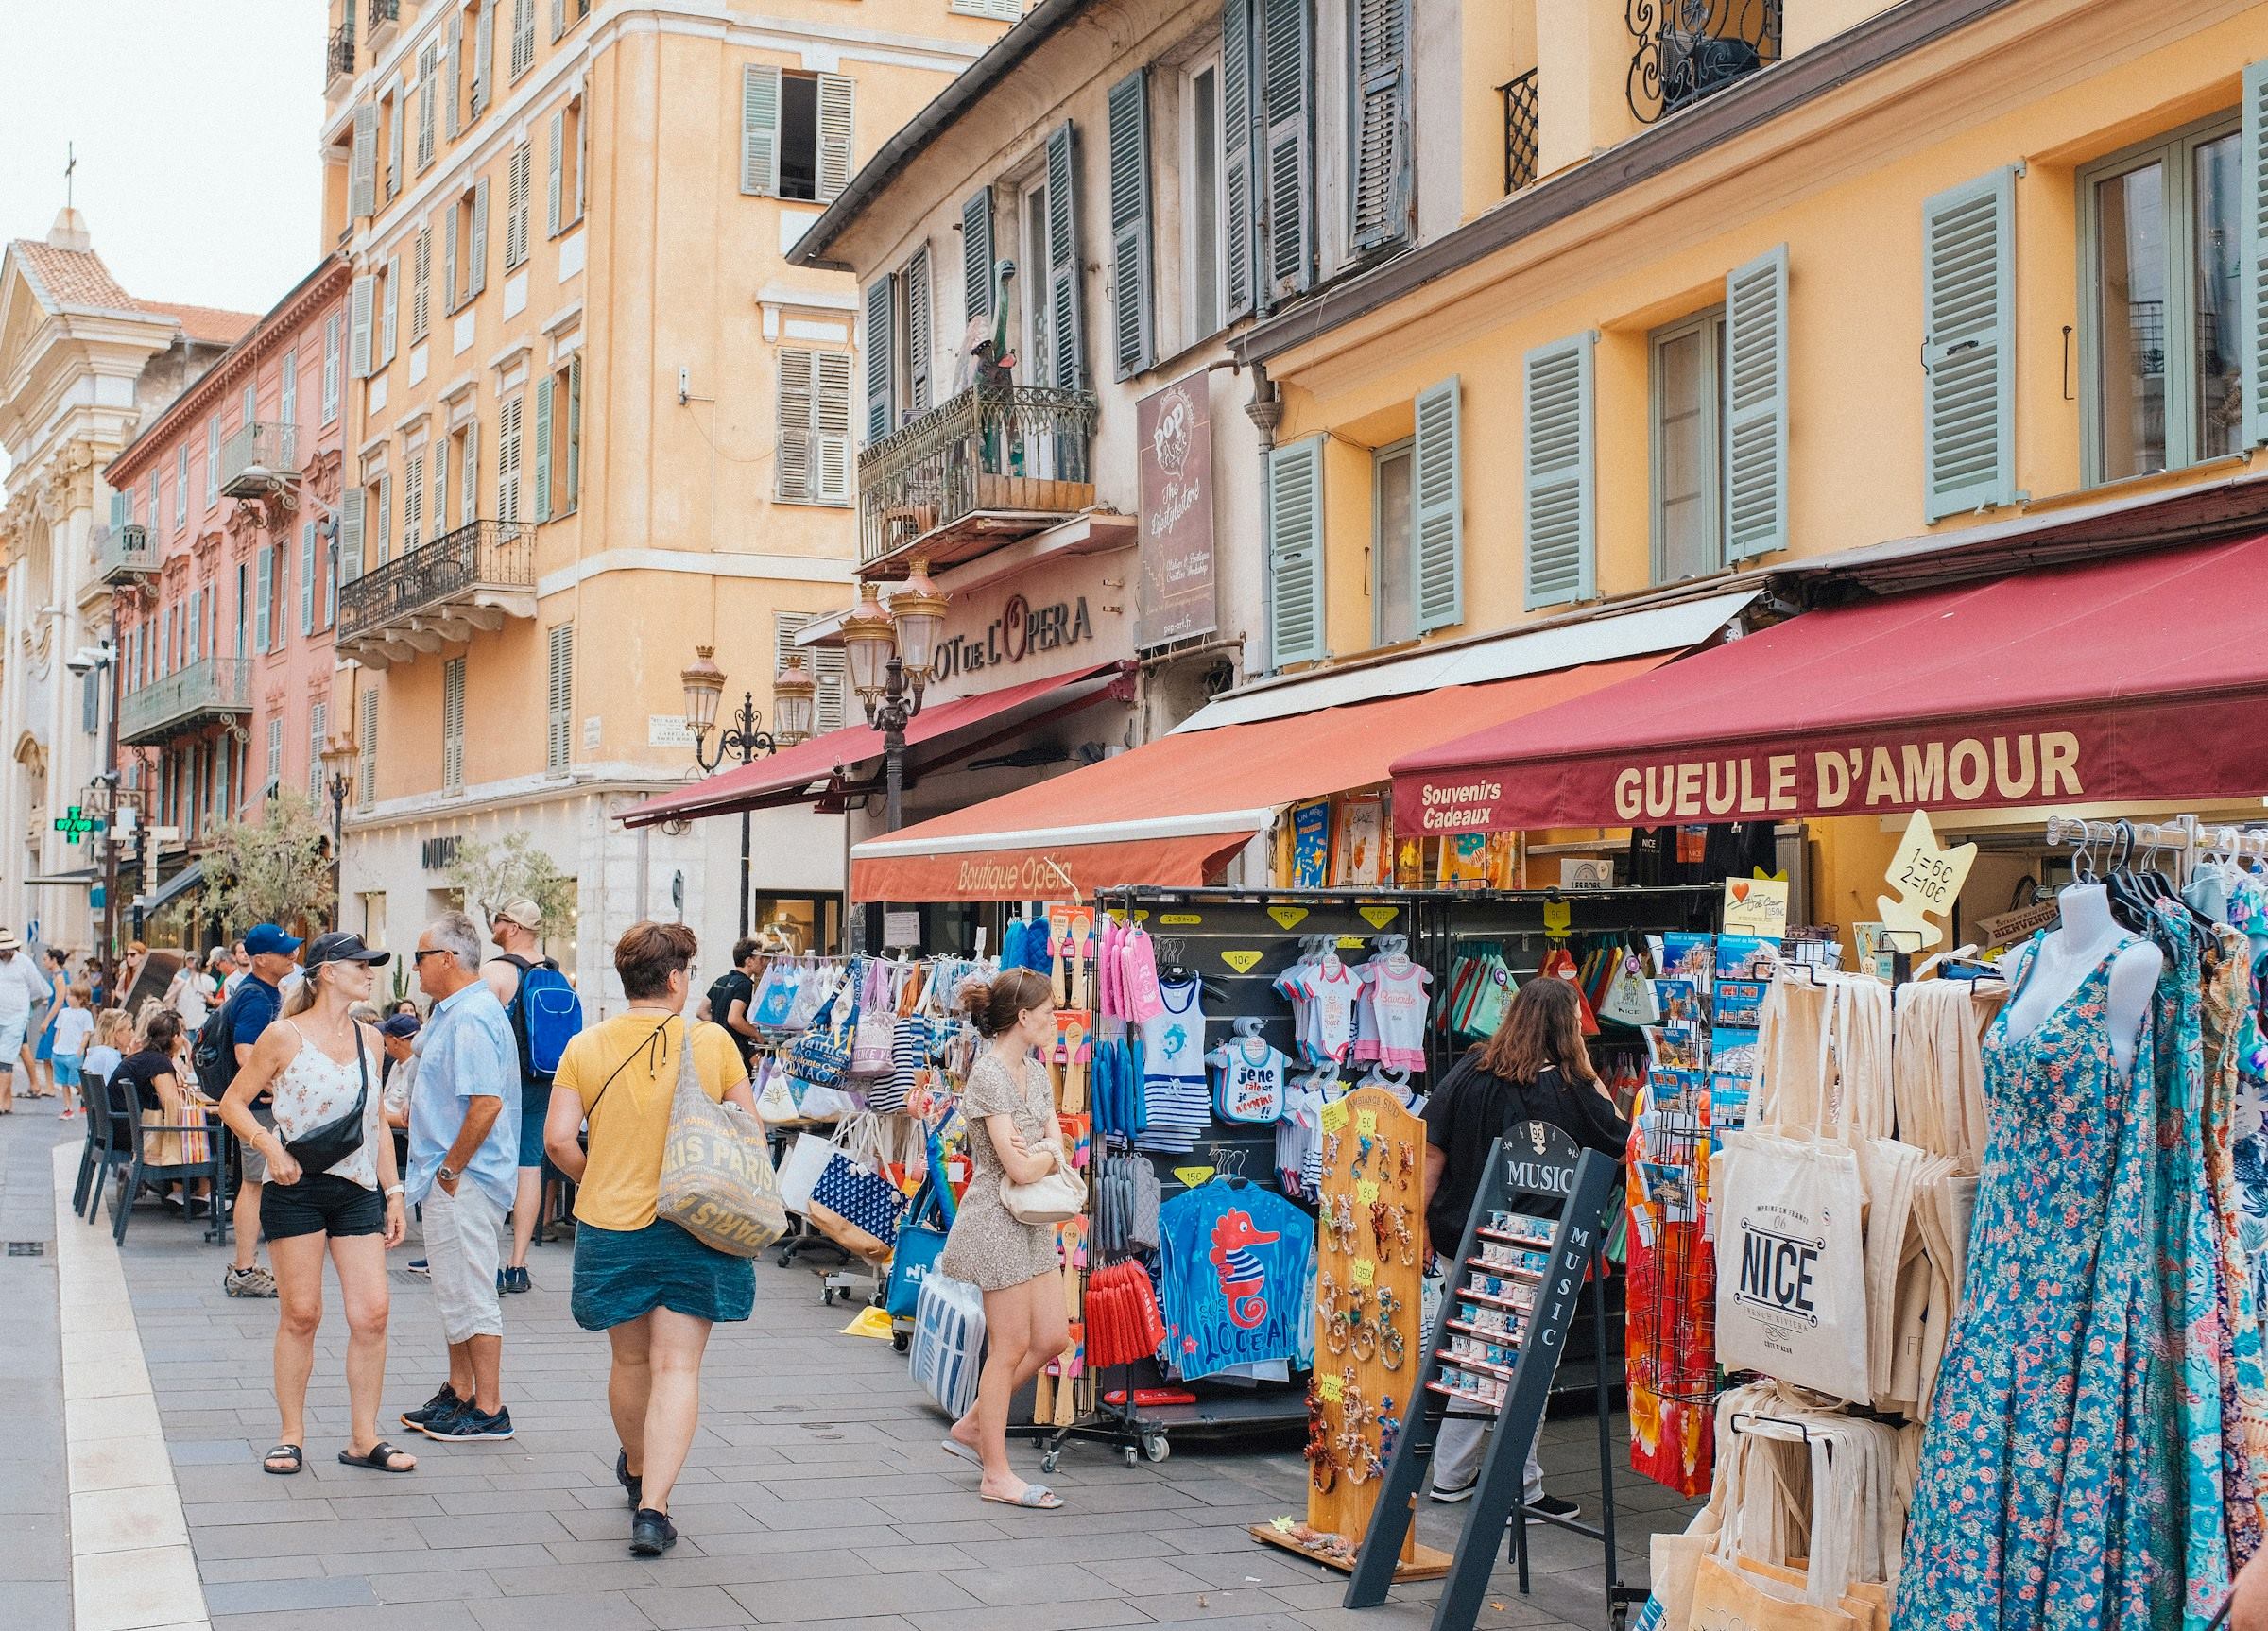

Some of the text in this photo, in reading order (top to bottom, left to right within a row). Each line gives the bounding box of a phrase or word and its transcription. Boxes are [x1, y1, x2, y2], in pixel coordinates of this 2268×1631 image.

[1161, 481, 1179, 505] The
[1614, 731, 2085, 820] GUEULE D'AMOUR
[1421, 779, 1502, 806] Souvenirs
[1423, 805, 1492, 830] Cadeaux
[1641, 838, 1657, 849] NICE
[957, 852, 1073, 897] Boutique Opéra
[1280, 911, 1297, 920] 15€
[1992, 908, 2057, 939] BIENVENUS
[1233, 956, 1250, 965] 10€
[1237, 1066, 1274, 1085] je ne
[1237, 1092, 1247, 1103] je
[1383, 1098, 1399, 1120] SUD
[1362, 1117, 1372, 1128] 5€
[713, 1138, 773, 1192] PARIS
[1186, 1172, 1202, 1181] 15€
[1506, 1160, 1575, 1193] MUSIC
[1773, 1215, 1787, 1229] 06
[1778, 1206, 1788, 1215] EN
[1740, 1231, 1818, 1313] NICE
[1541, 1226, 1590, 1347] MUSIC
[1743, 1305, 1809, 1332] FRENCH RIVIERA
